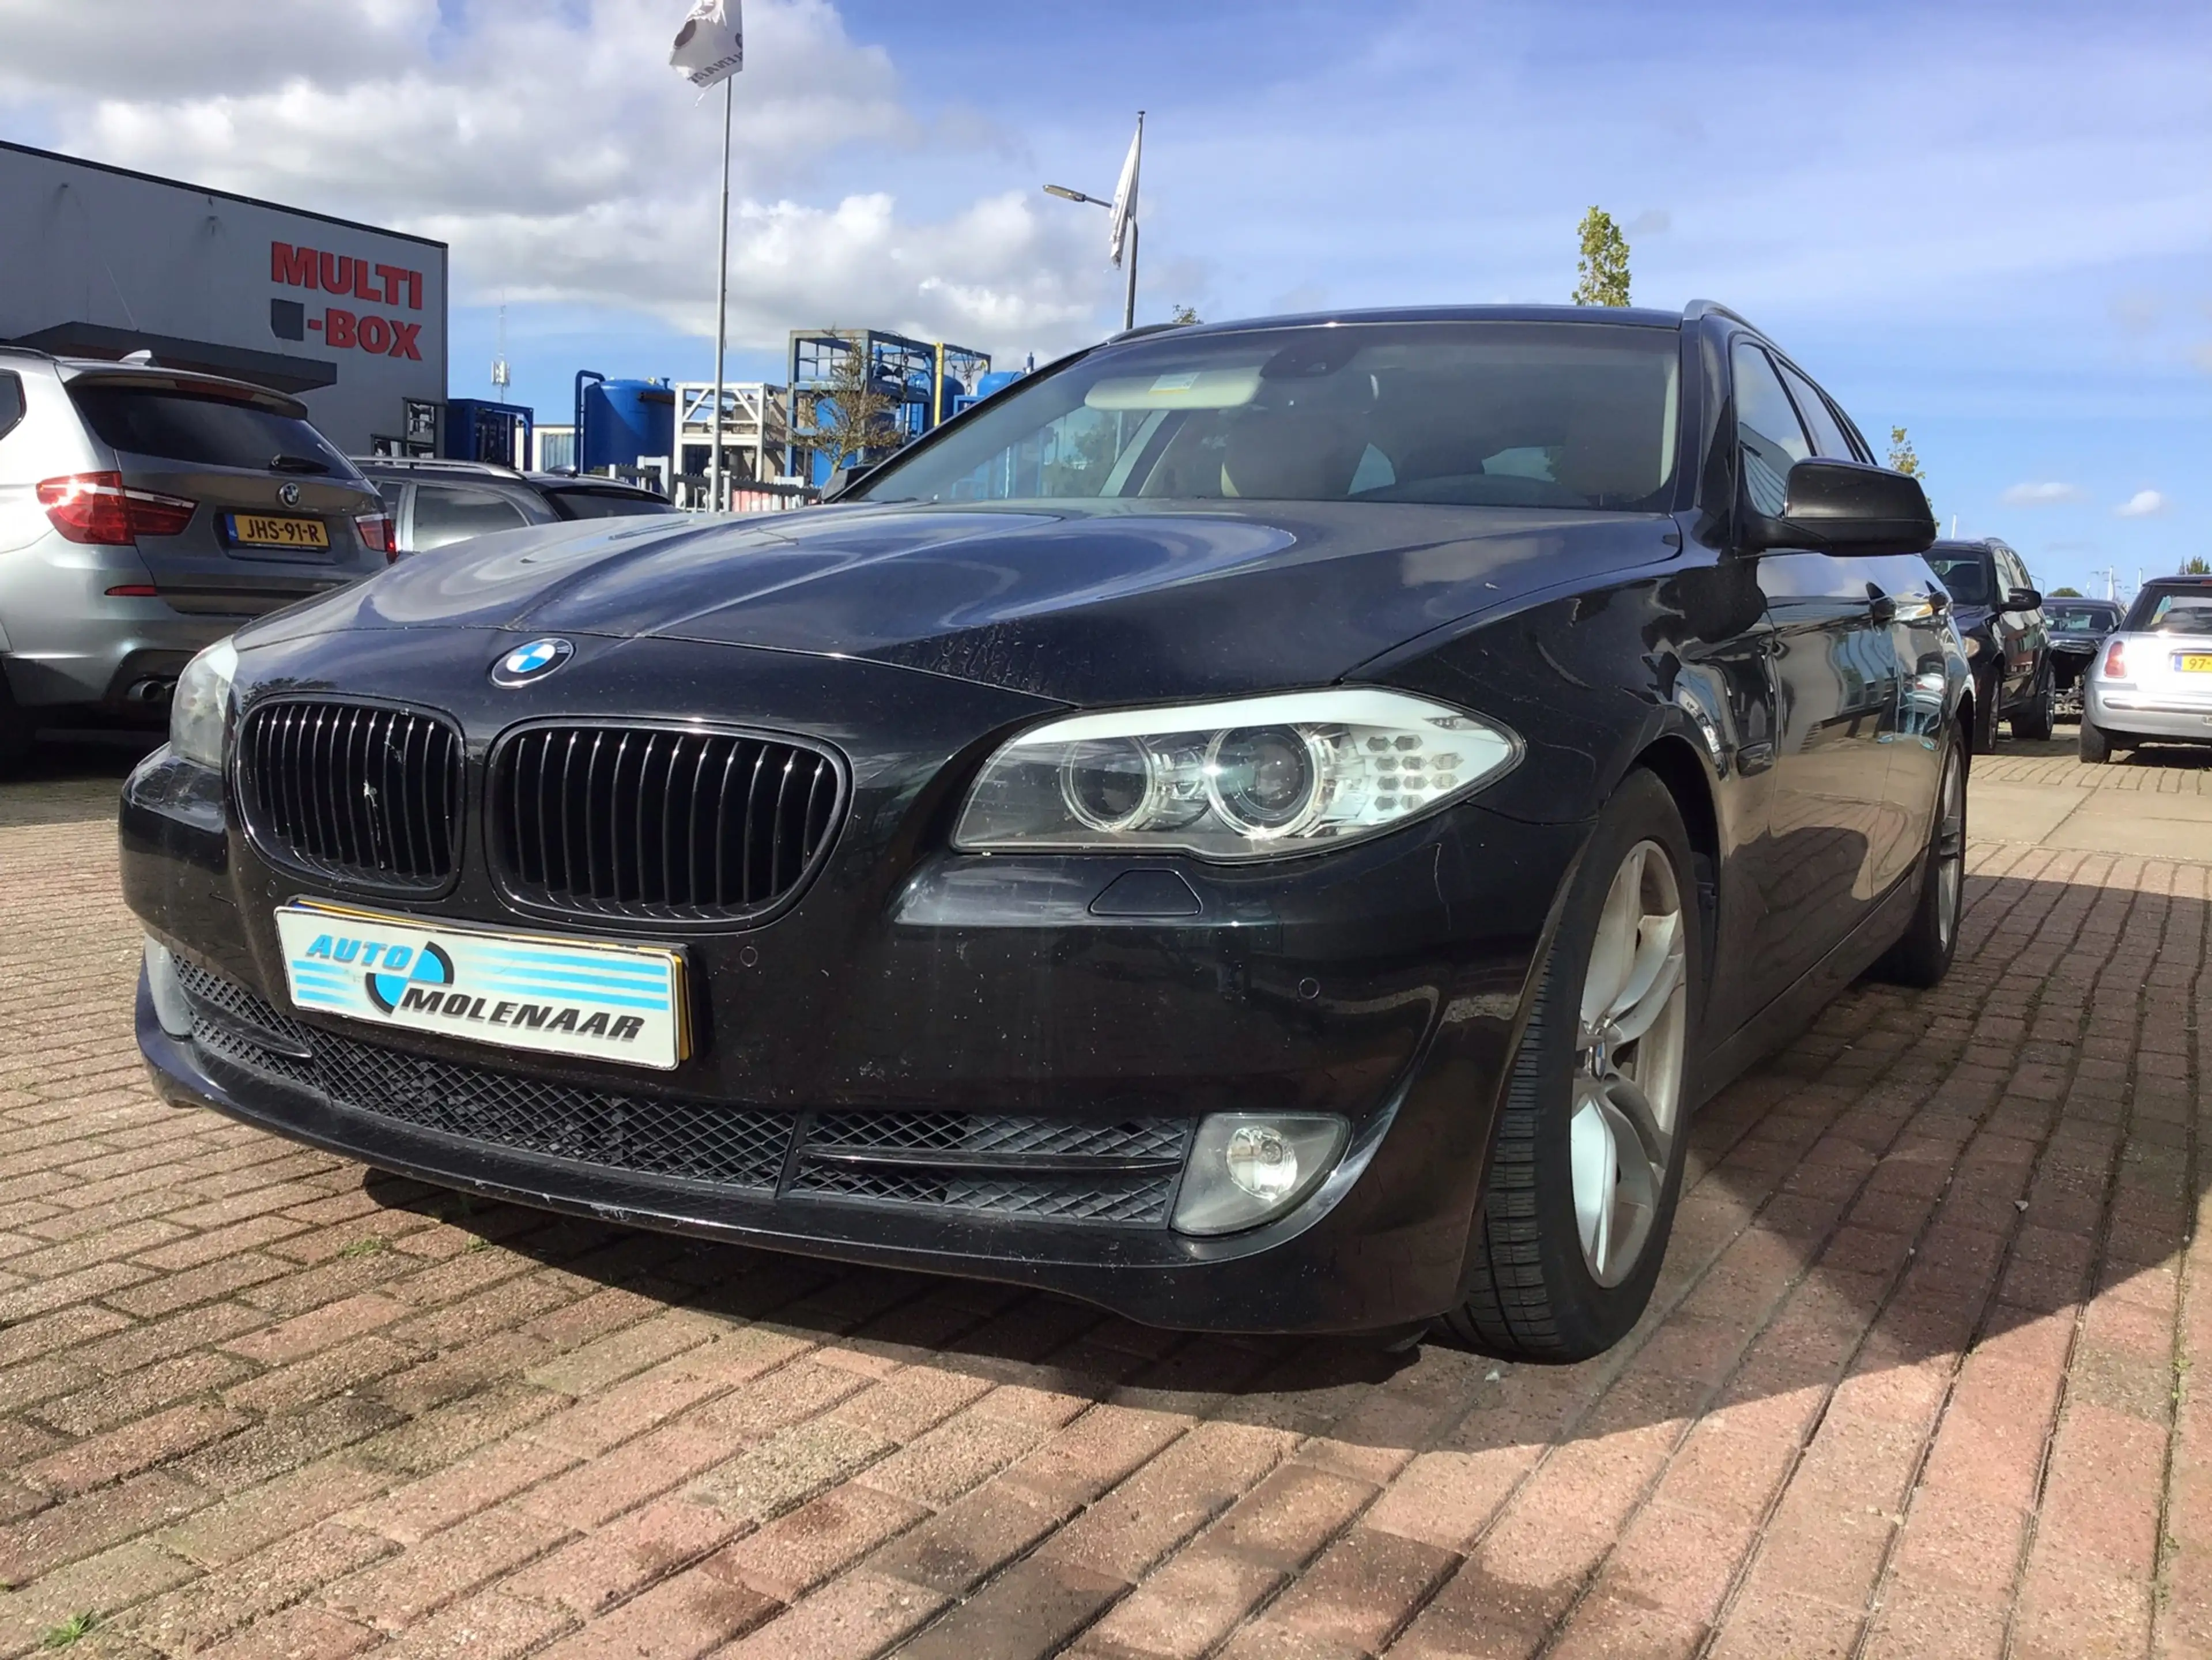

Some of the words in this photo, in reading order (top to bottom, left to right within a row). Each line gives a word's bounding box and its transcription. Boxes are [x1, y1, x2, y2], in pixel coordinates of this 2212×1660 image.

[271, 241, 422, 310] MULTI
[247, 519, 321, 543] JHS-91-R
[305, 934, 414, 971] AUTO
[401, 987, 646, 1042] MOLENAAR
